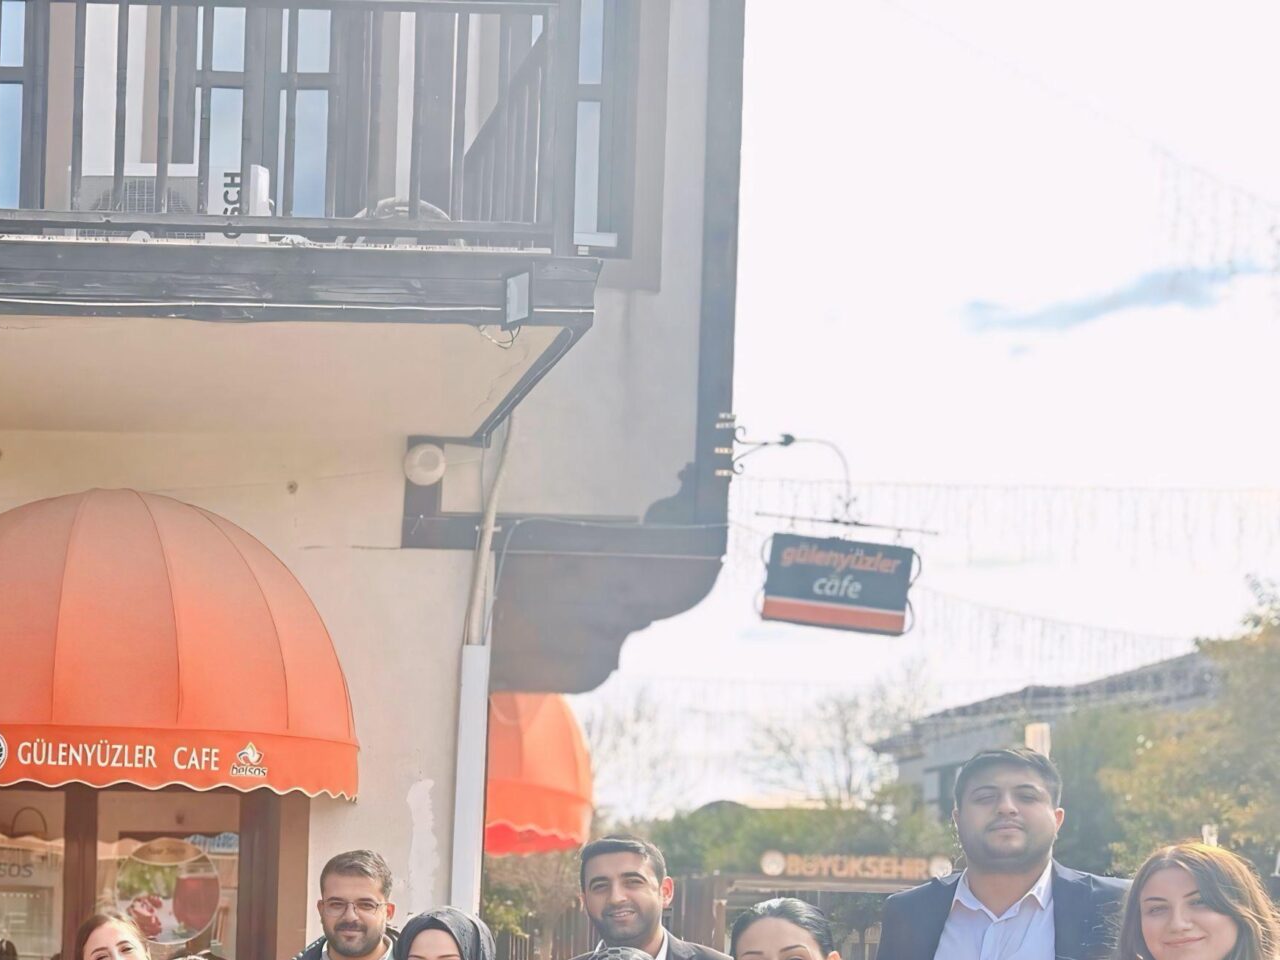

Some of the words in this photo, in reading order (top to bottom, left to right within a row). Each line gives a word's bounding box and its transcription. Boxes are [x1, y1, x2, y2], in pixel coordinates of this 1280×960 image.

[18, 738, 157, 768] GÜLENYÜZLER
[173, 747, 219, 771] CAFE
[230, 764, 268, 777] belsos
